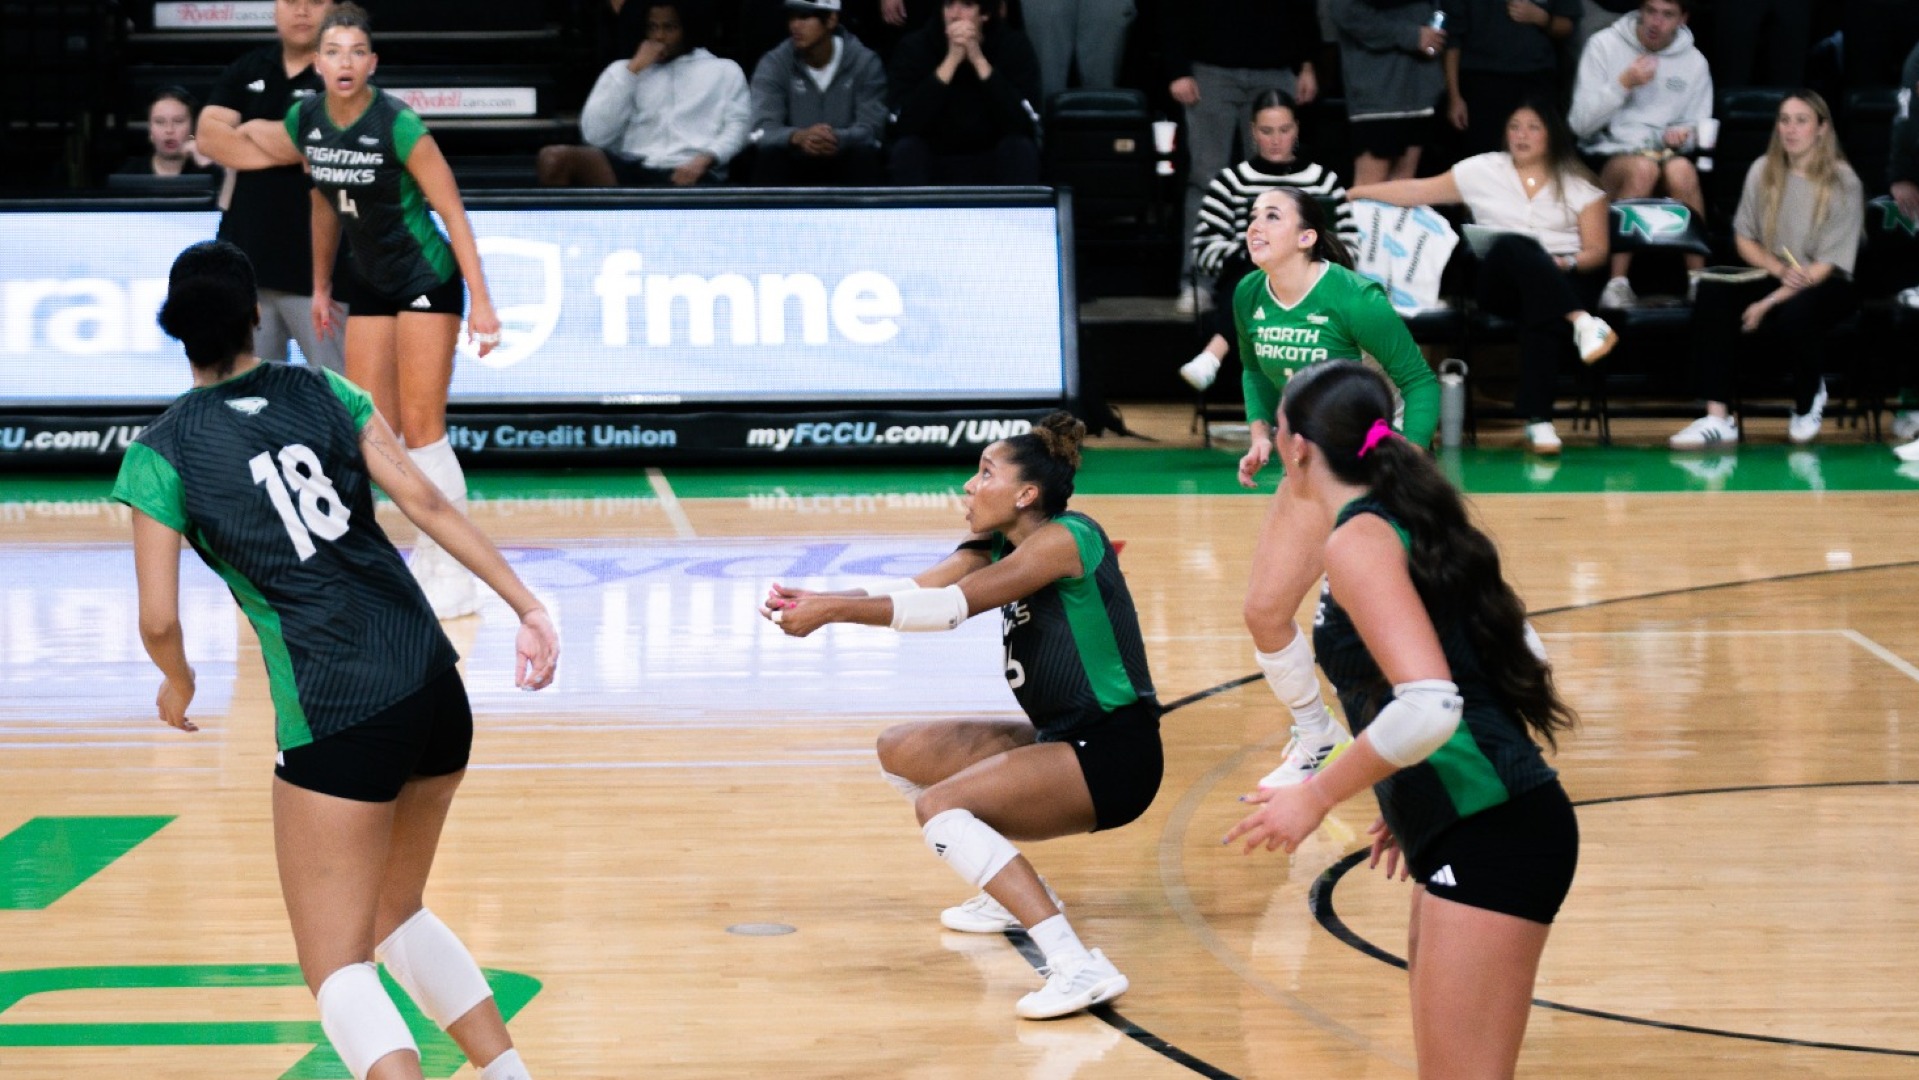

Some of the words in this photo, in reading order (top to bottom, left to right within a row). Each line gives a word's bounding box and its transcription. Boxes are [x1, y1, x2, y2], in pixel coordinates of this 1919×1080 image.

[305, 145, 384, 165] FIGHTING
[310, 165, 375, 183] HAWKS
[338, 189, 359, 218] 4
[594, 249, 903, 347] fmne
[1256, 325, 1321, 344] NORTH
[1254, 341, 1329, 362] DAKOTA
[494, 425, 586, 446] Credit
[594, 425, 678, 446] Union
[249, 443, 352, 562] 18
